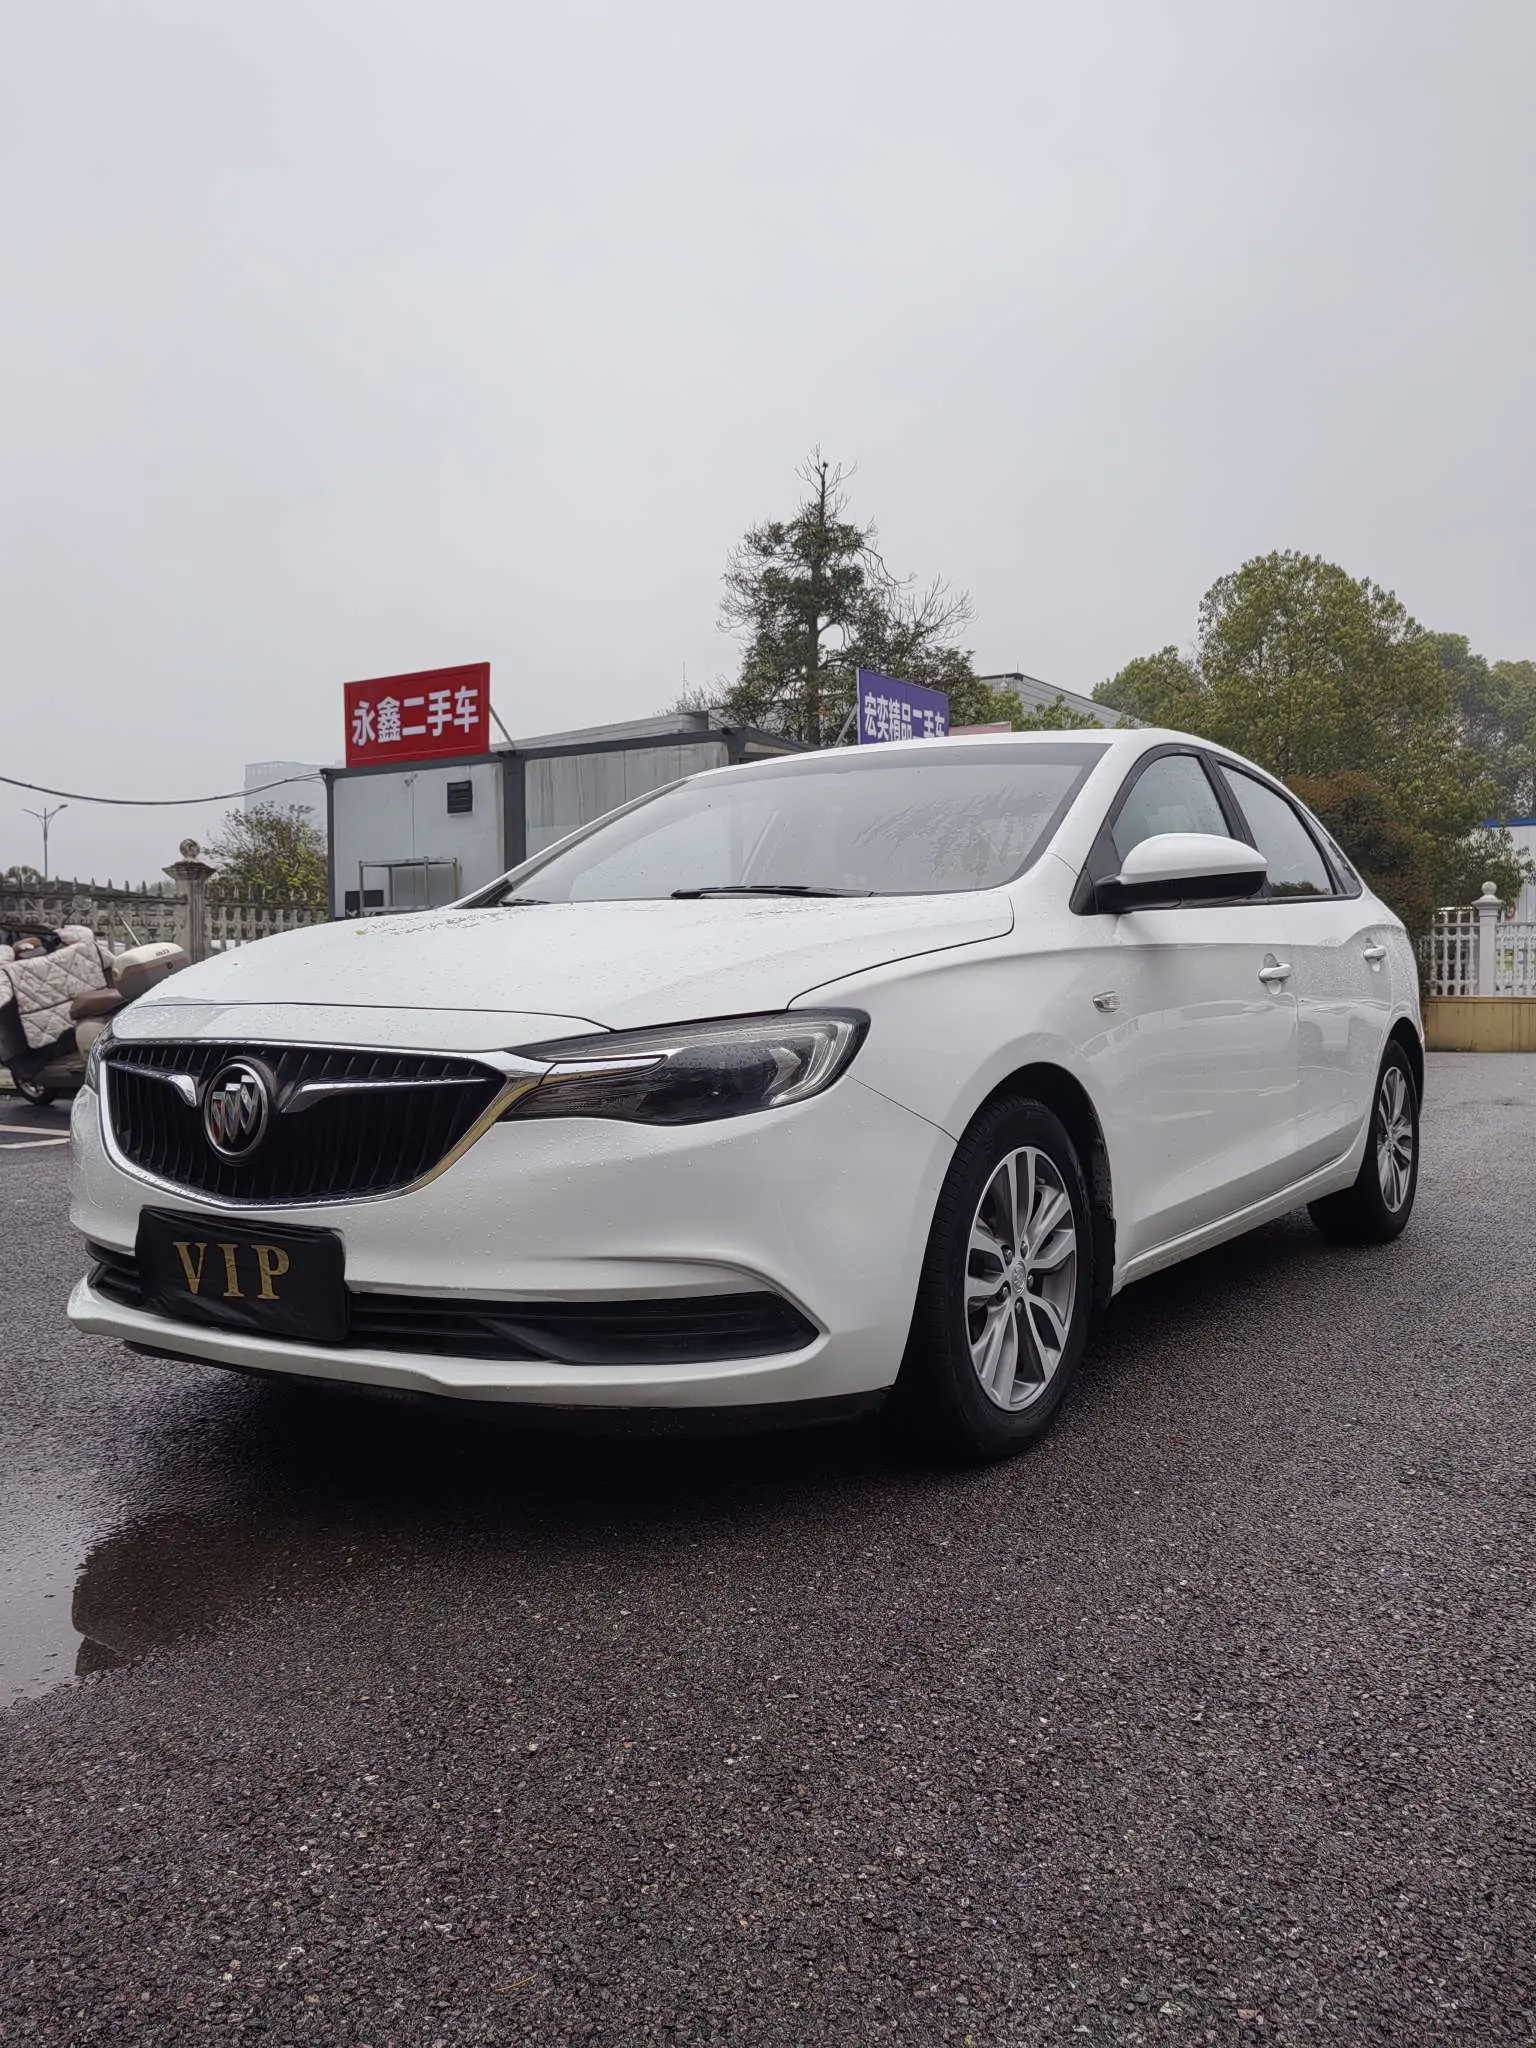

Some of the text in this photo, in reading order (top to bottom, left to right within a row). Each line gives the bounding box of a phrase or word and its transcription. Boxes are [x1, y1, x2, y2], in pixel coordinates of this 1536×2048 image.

[352, 686, 479, 746] 永鑫二手车
[173, 1241, 290, 1300] VIP
